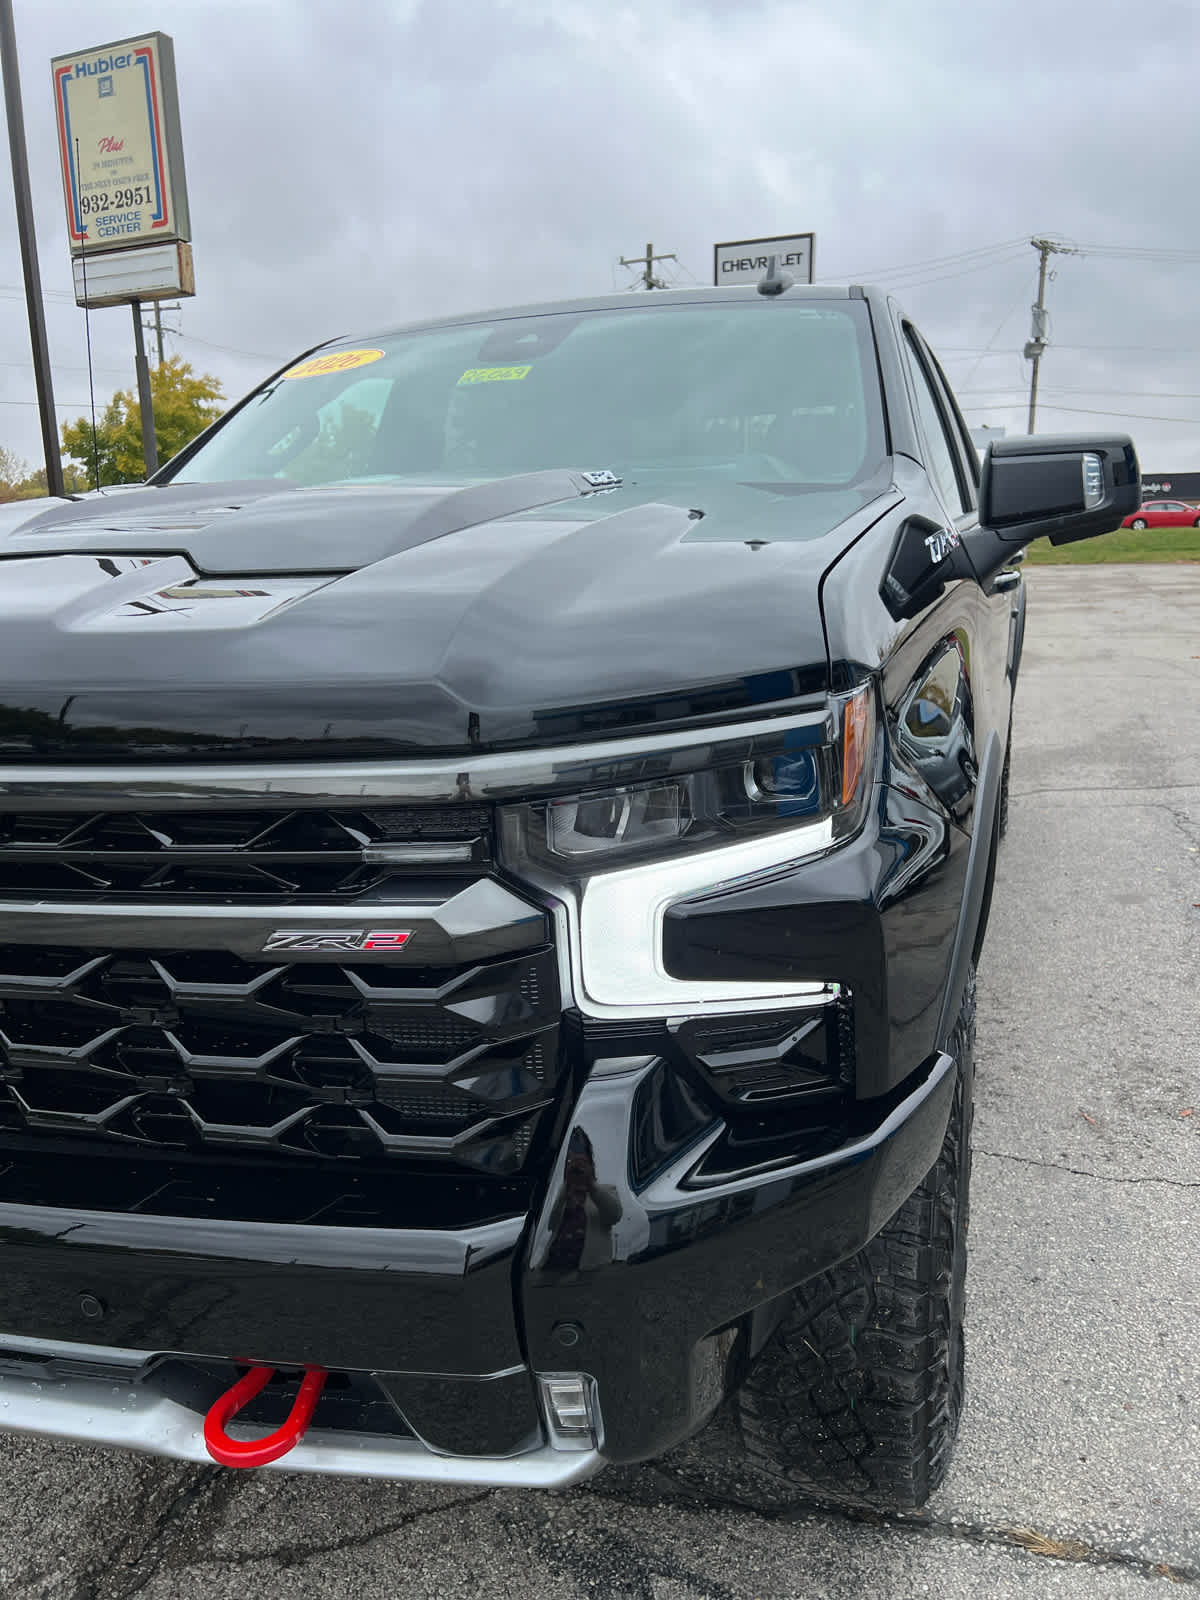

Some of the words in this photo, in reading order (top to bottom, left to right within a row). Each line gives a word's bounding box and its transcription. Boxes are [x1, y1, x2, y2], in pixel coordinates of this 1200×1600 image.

[75, 54, 132, 78] Hubler
[98, 136, 124, 153] Plus
[81, 185, 152, 215] 932-2951
[96, 211, 142, 227] SERVICE
[97, 222, 142, 237] CENTER
[722, 252, 803, 273] CHEVRLET
[262, 930, 412, 951] ZR2
